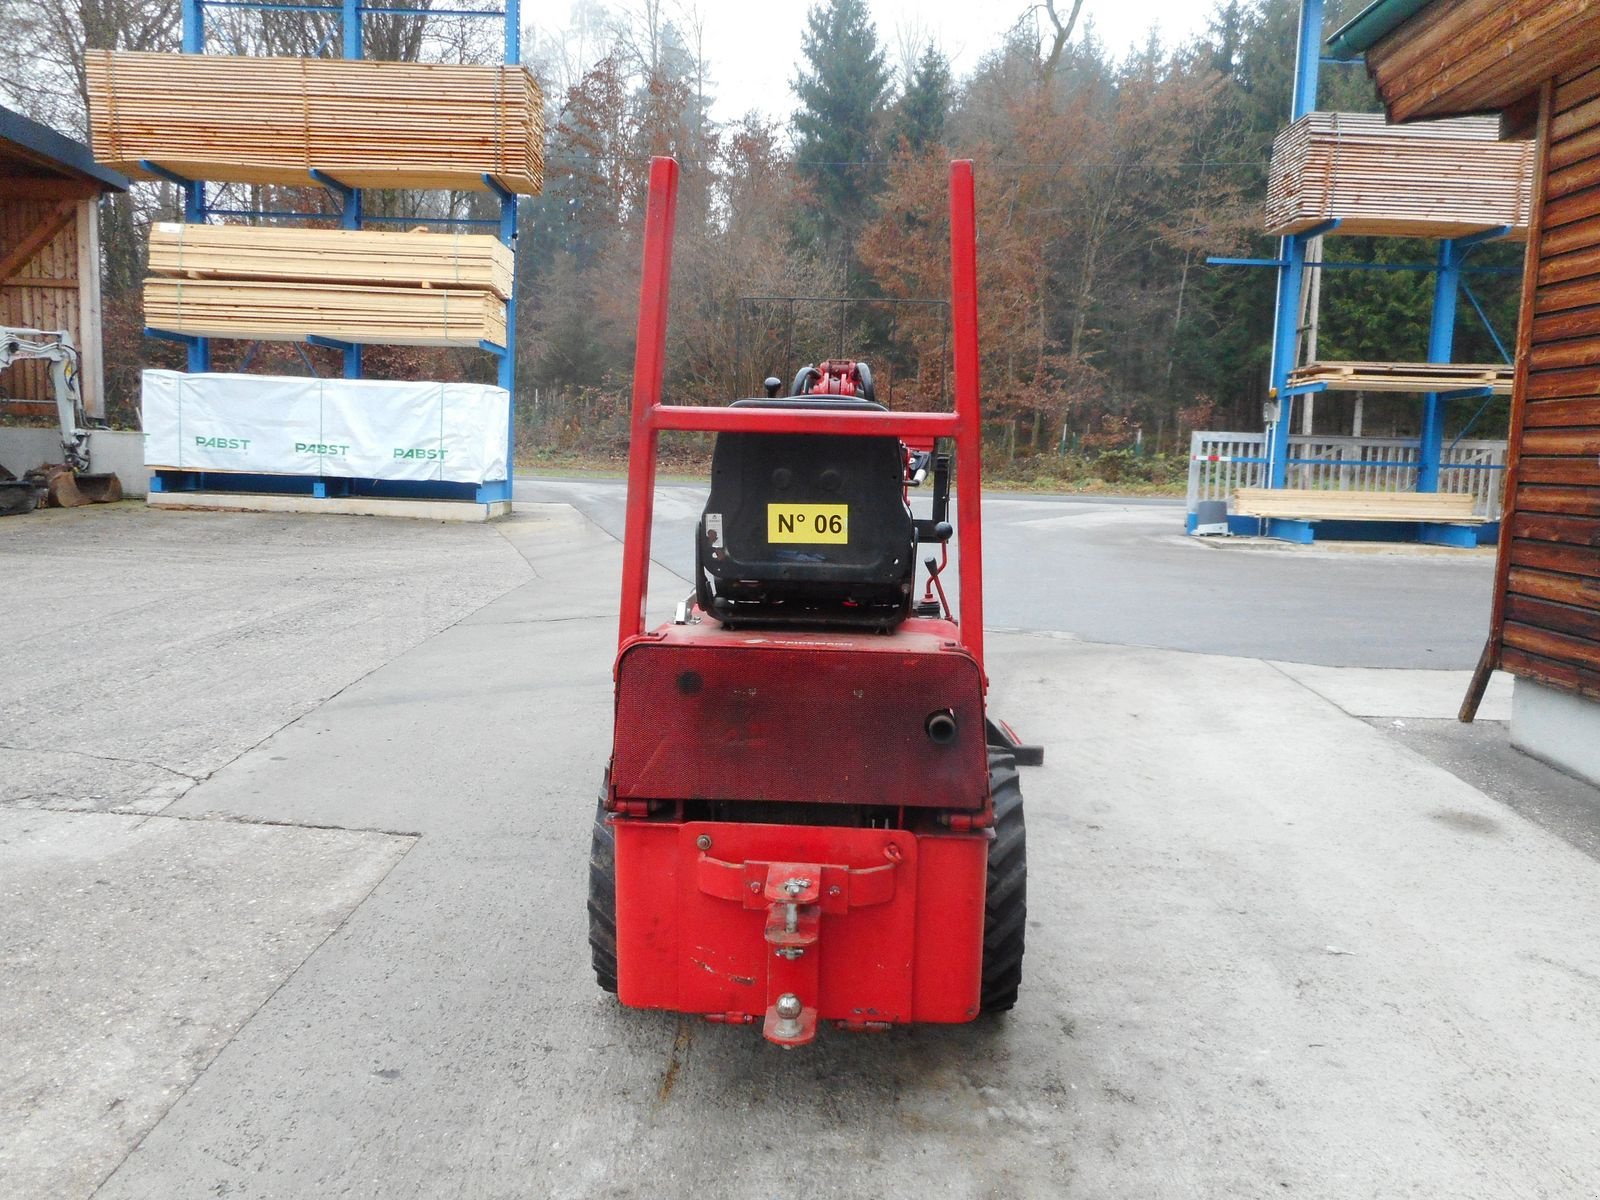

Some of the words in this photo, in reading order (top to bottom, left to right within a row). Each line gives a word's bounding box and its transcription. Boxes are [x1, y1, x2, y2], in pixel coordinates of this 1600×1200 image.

[195, 436, 251, 450] PABST
[295, 442, 349, 456] PABST
[393, 448, 448, 460] PABST
[814, 514, 842, 534] 06
